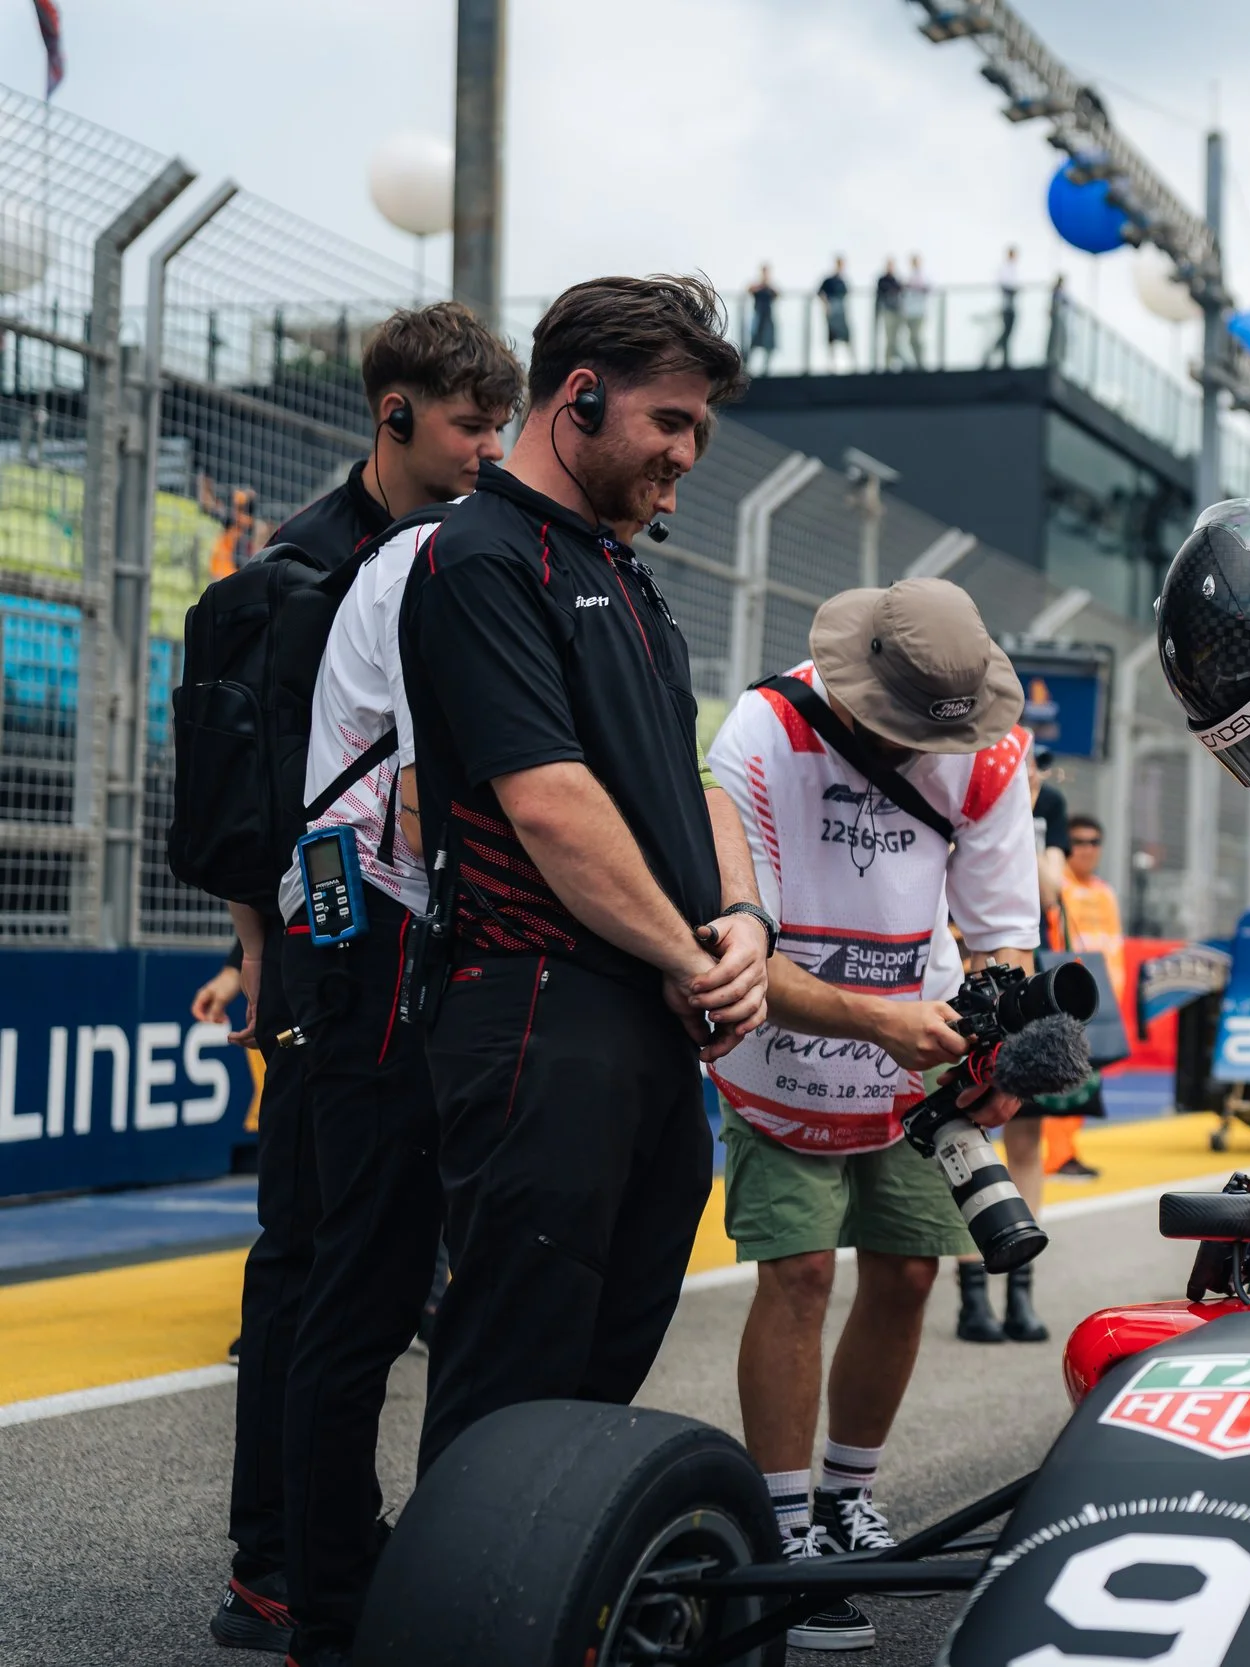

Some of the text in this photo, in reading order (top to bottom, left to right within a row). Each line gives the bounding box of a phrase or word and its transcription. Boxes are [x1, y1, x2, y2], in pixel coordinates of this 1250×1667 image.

[821, 818, 917, 853] 2256SGP
[846, 945, 915, 967] Support
[844, 962, 901, 982] Event
[0, 1022, 232, 1143] LINES
[776, 1075, 897, 1098] 03-05.10.2025
